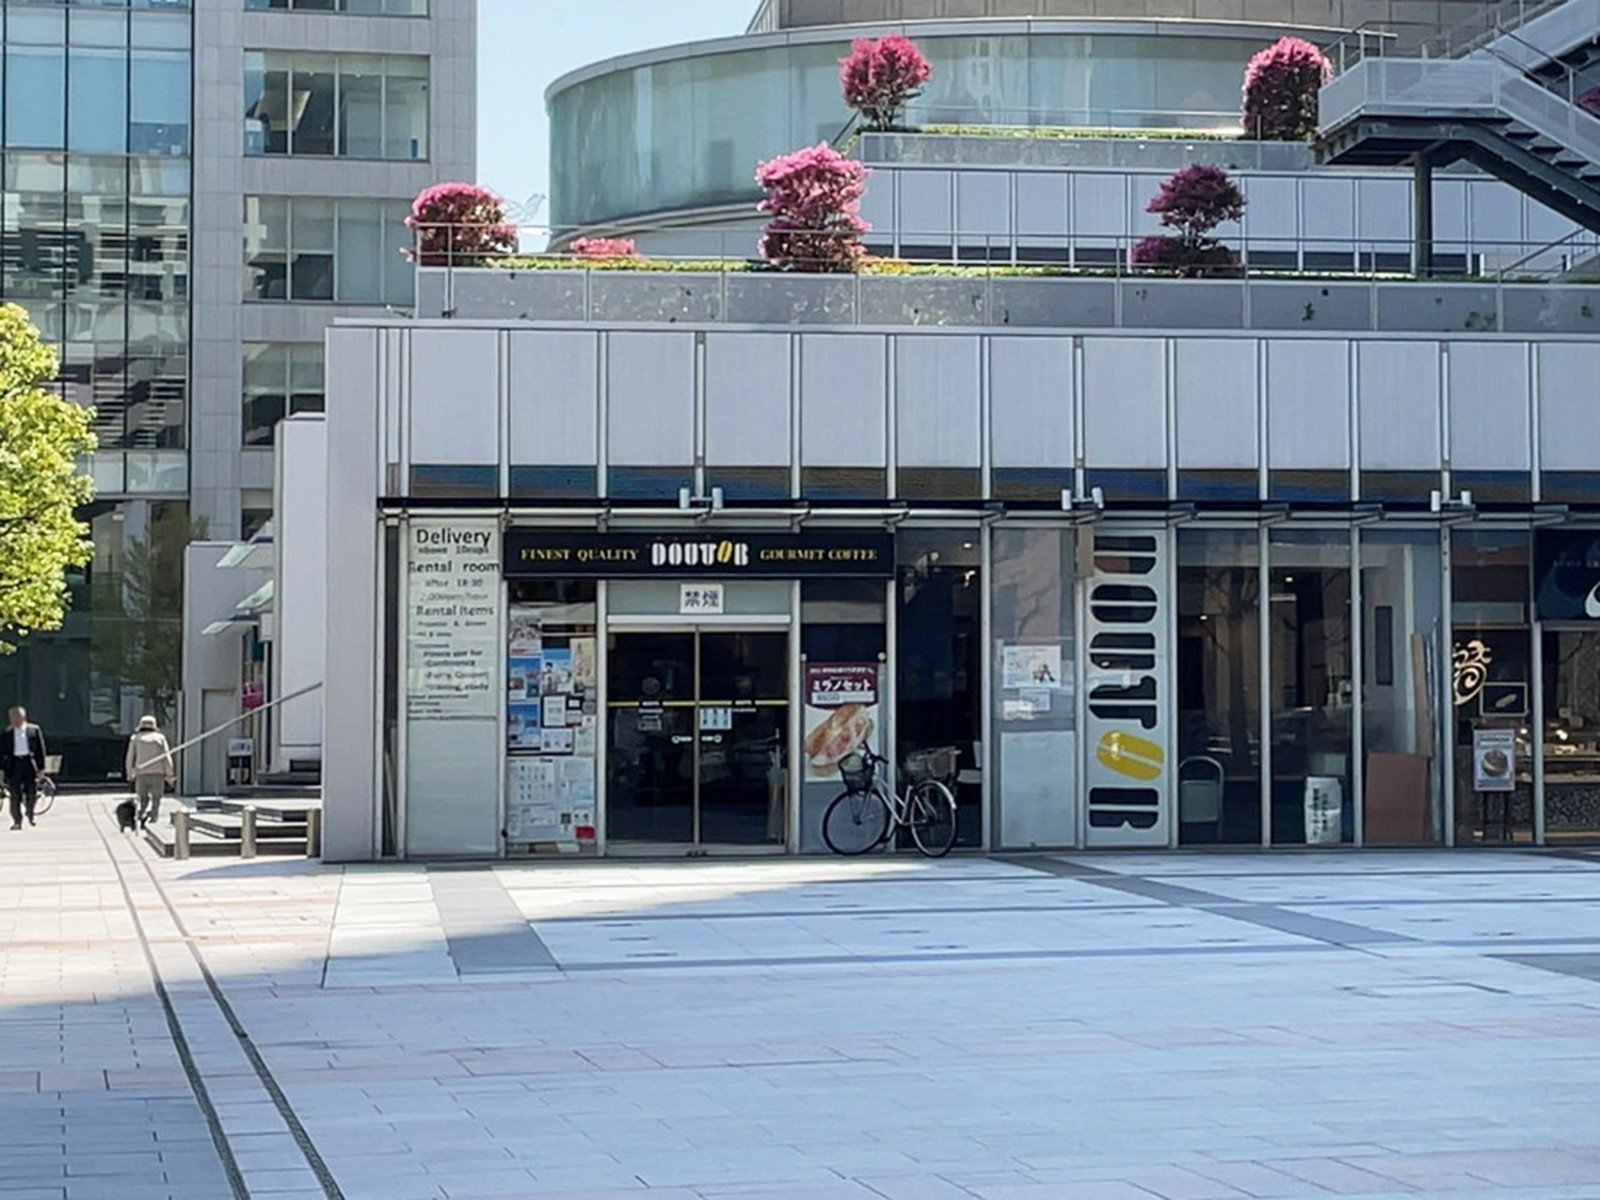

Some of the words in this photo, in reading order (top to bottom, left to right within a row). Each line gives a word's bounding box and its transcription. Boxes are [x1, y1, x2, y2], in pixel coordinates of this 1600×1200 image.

[416, 527, 491, 547] Delivery
[521, 549, 570, 560] FINEST
[577, 549, 638, 562] QUALITY
[651, 540, 749, 566] DOUTOR
[760, 549, 823, 560] GOURMET
[828, 549, 877, 560] COFFEE
[408, 560, 452, 573] Rental
[463, 562, 500, 573] room
[684, 590, 719, 608] 禁煙
[416, 604, 456, 616] Rental
